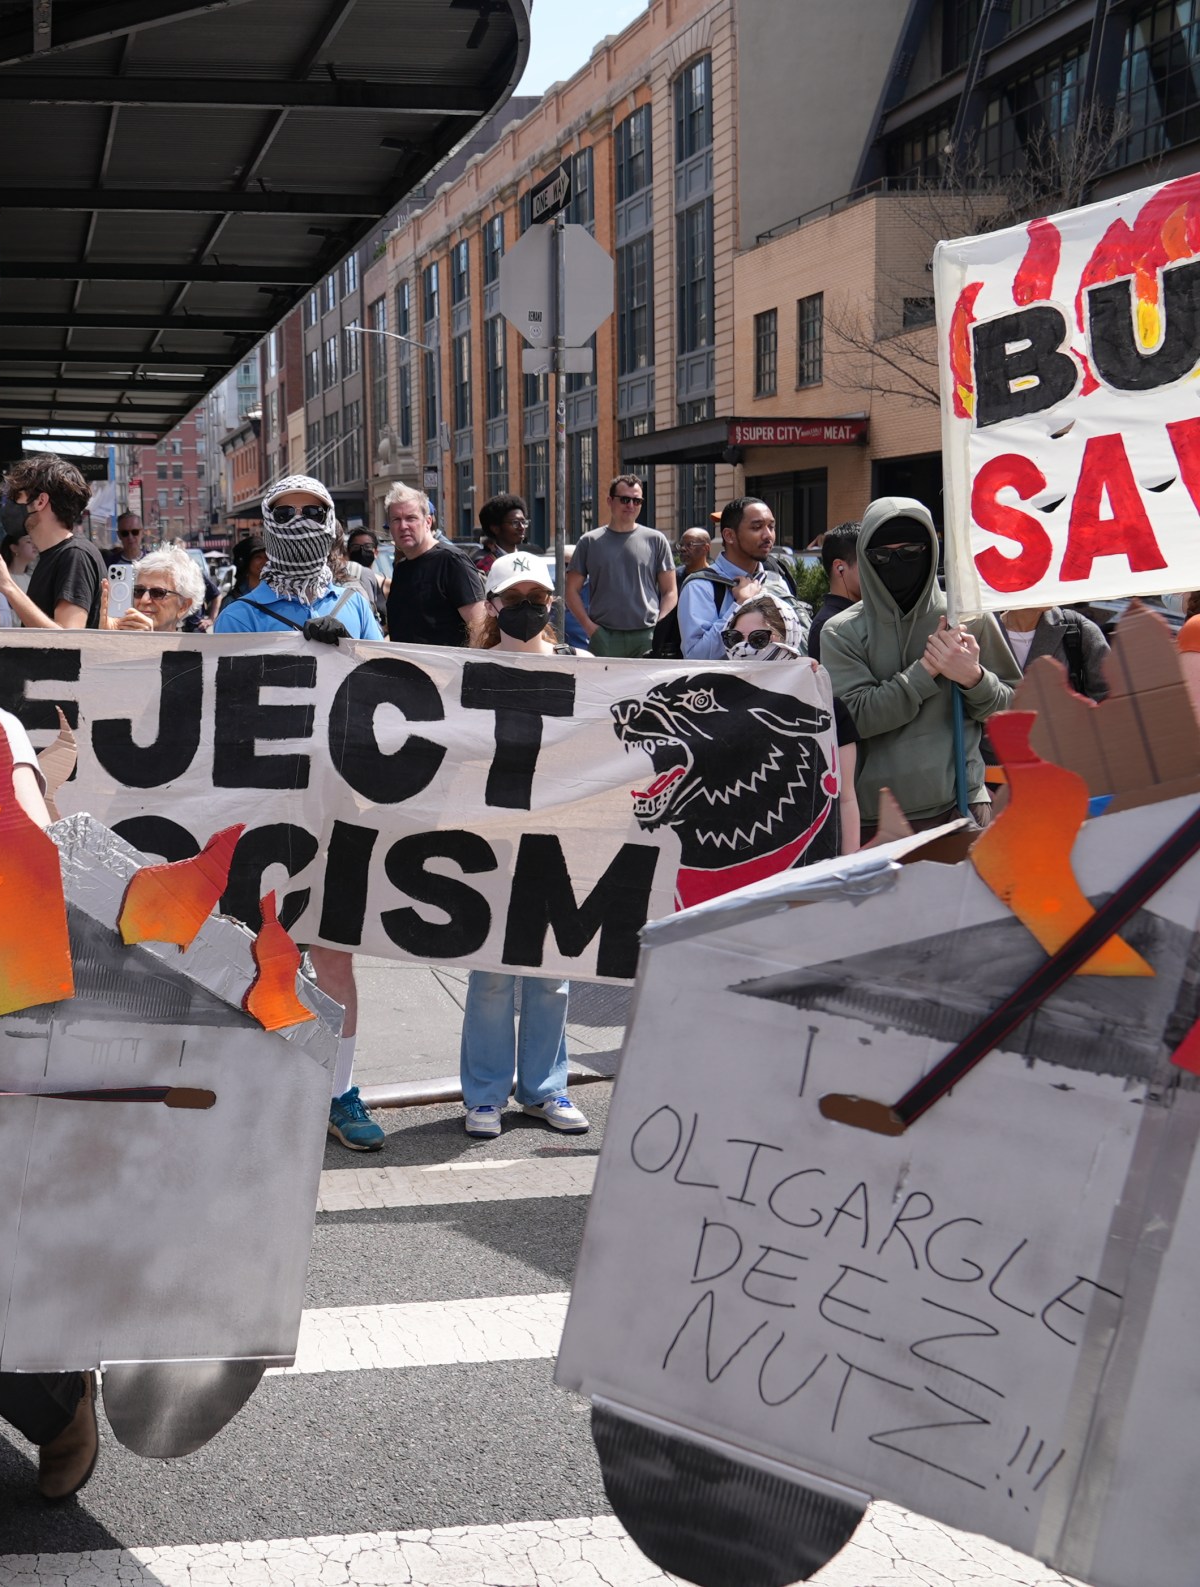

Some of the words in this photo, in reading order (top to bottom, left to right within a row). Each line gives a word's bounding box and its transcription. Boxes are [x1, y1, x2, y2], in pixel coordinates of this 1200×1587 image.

[535, 190, 548, 214] ONE
[553, 175, 566, 201] WAY
[743, 426, 774, 440] SUPER
[777, 426, 801, 440] CITY
[824, 425, 851, 440] MEAT
[630, 1104, 1123, 1345] OLIGARGLE
[690, 1217, 1006, 1399] DEEZ
[662, 1290, 1065, 1512] NUTZ!!!
